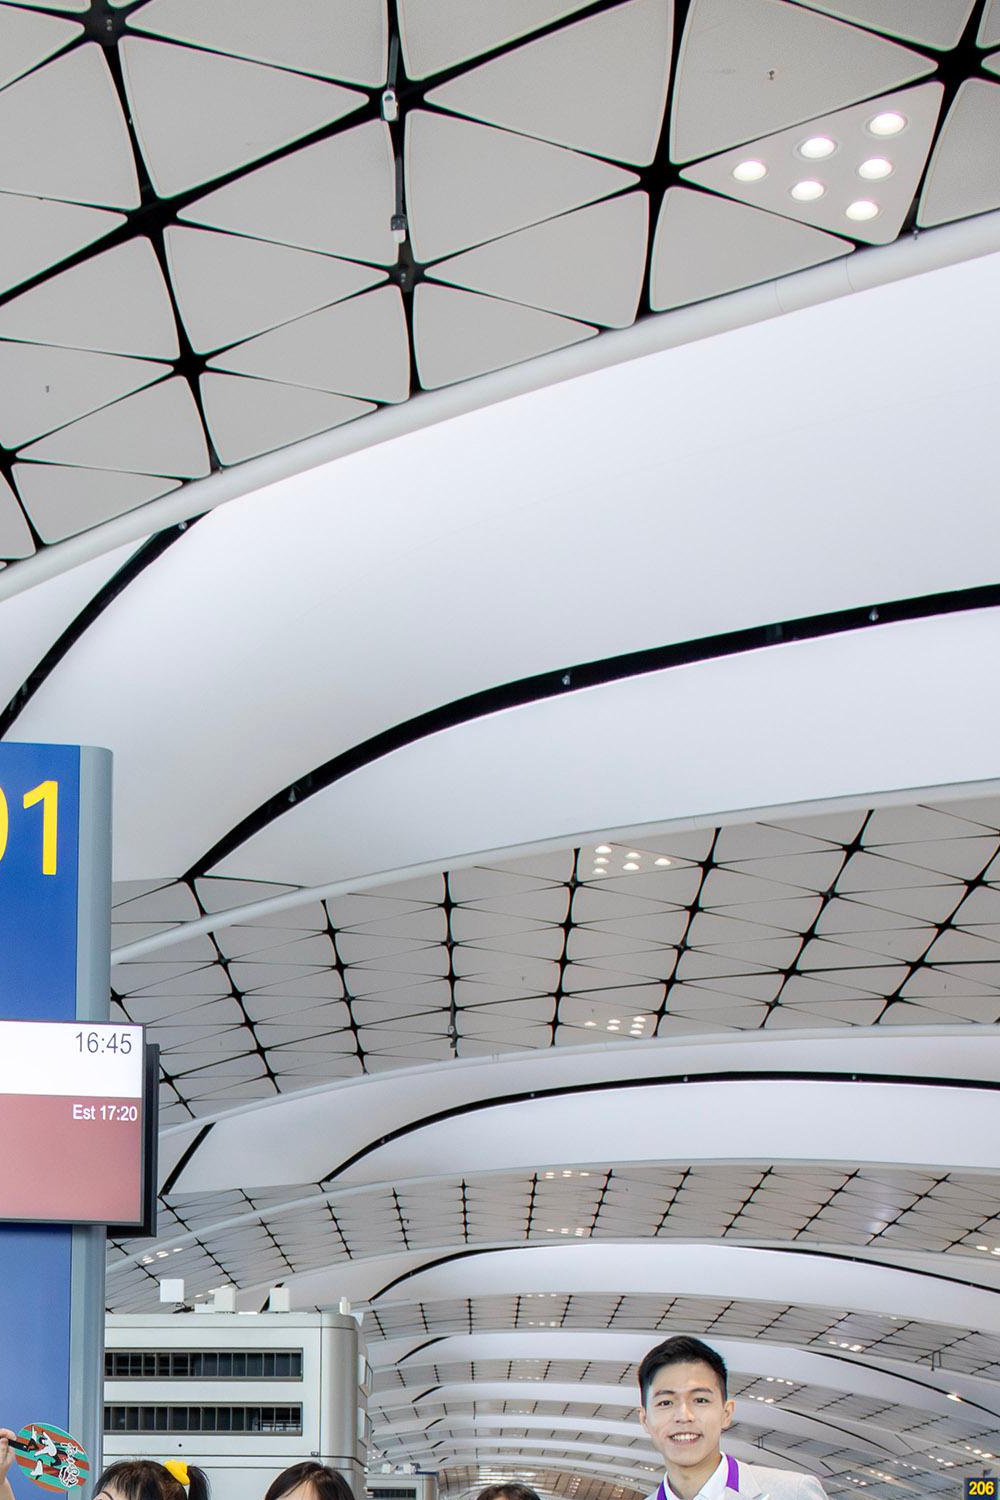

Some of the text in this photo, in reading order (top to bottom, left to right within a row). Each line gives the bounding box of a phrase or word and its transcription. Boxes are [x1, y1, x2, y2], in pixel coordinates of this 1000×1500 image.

[75, 1032, 133, 1055] 16:45
[72, 1104, 138, 1122] Est 17:20
[968, 1481, 994, 1496] 206
